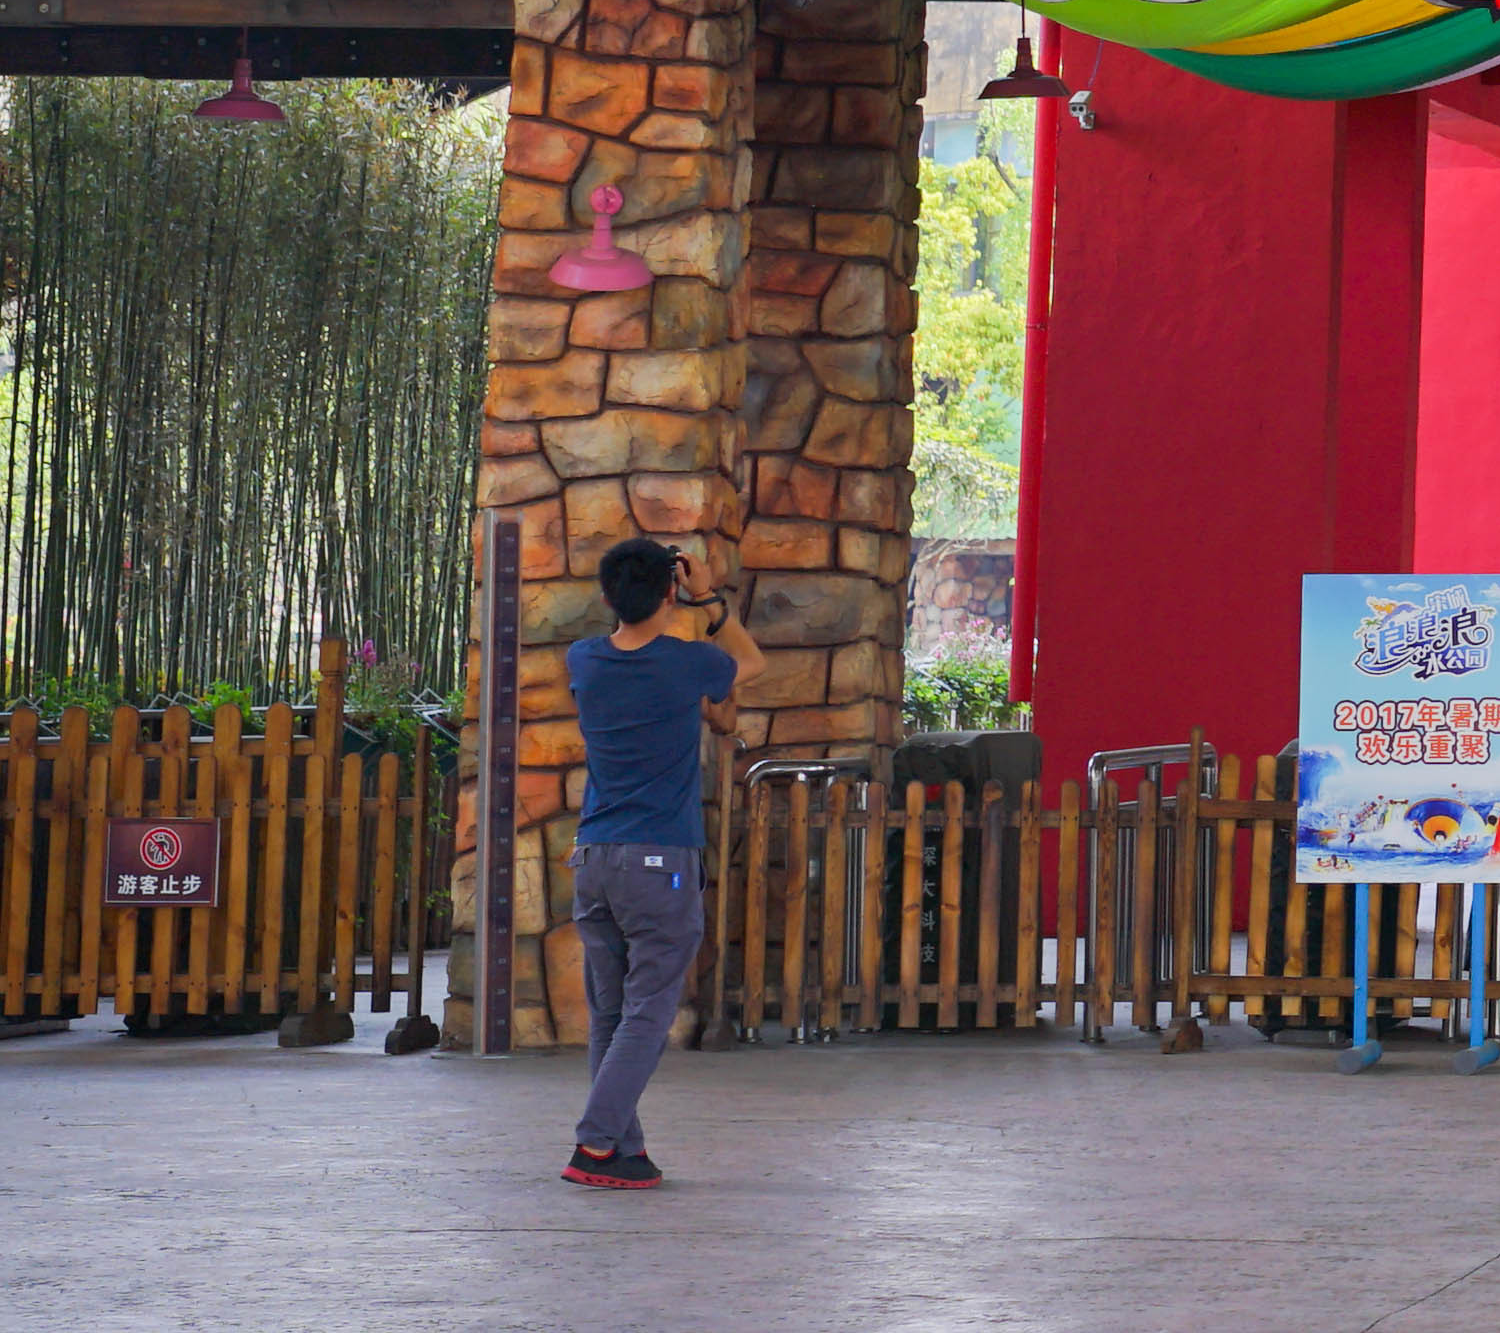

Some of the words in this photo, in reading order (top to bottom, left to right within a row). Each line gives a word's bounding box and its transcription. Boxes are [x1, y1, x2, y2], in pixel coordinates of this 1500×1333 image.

[1358, 732, 1489, 763] 欢乐重聚
[117, 874, 202, 896] 游客止步
